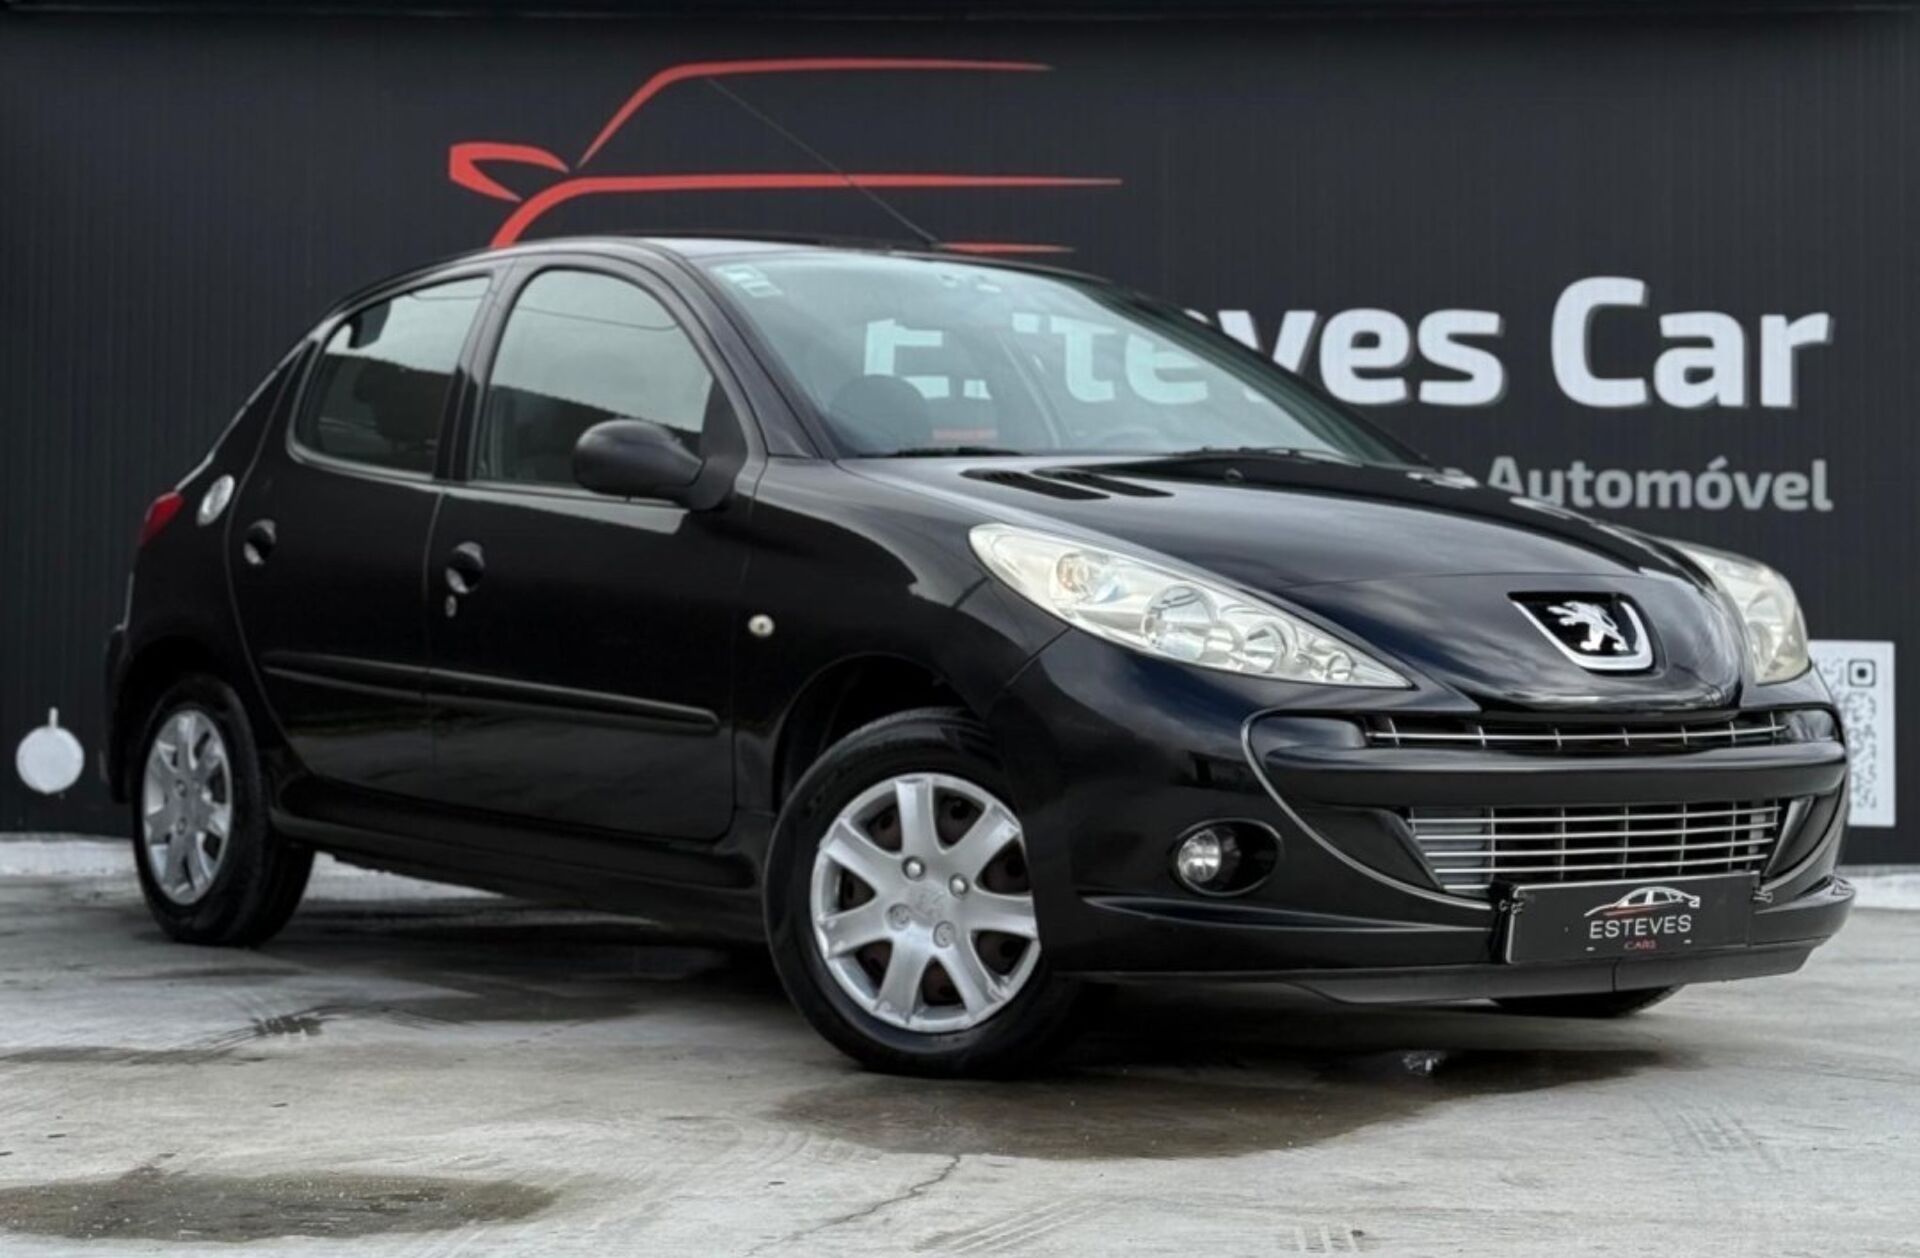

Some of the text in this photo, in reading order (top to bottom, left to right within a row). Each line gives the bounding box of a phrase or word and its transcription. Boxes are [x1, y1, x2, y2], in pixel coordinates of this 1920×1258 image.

[1550, 276, 1831, 409] Car
[1486, 455, 1833, 512] Automóvel
[1589, 914, 1693, 940] ESTEVES
